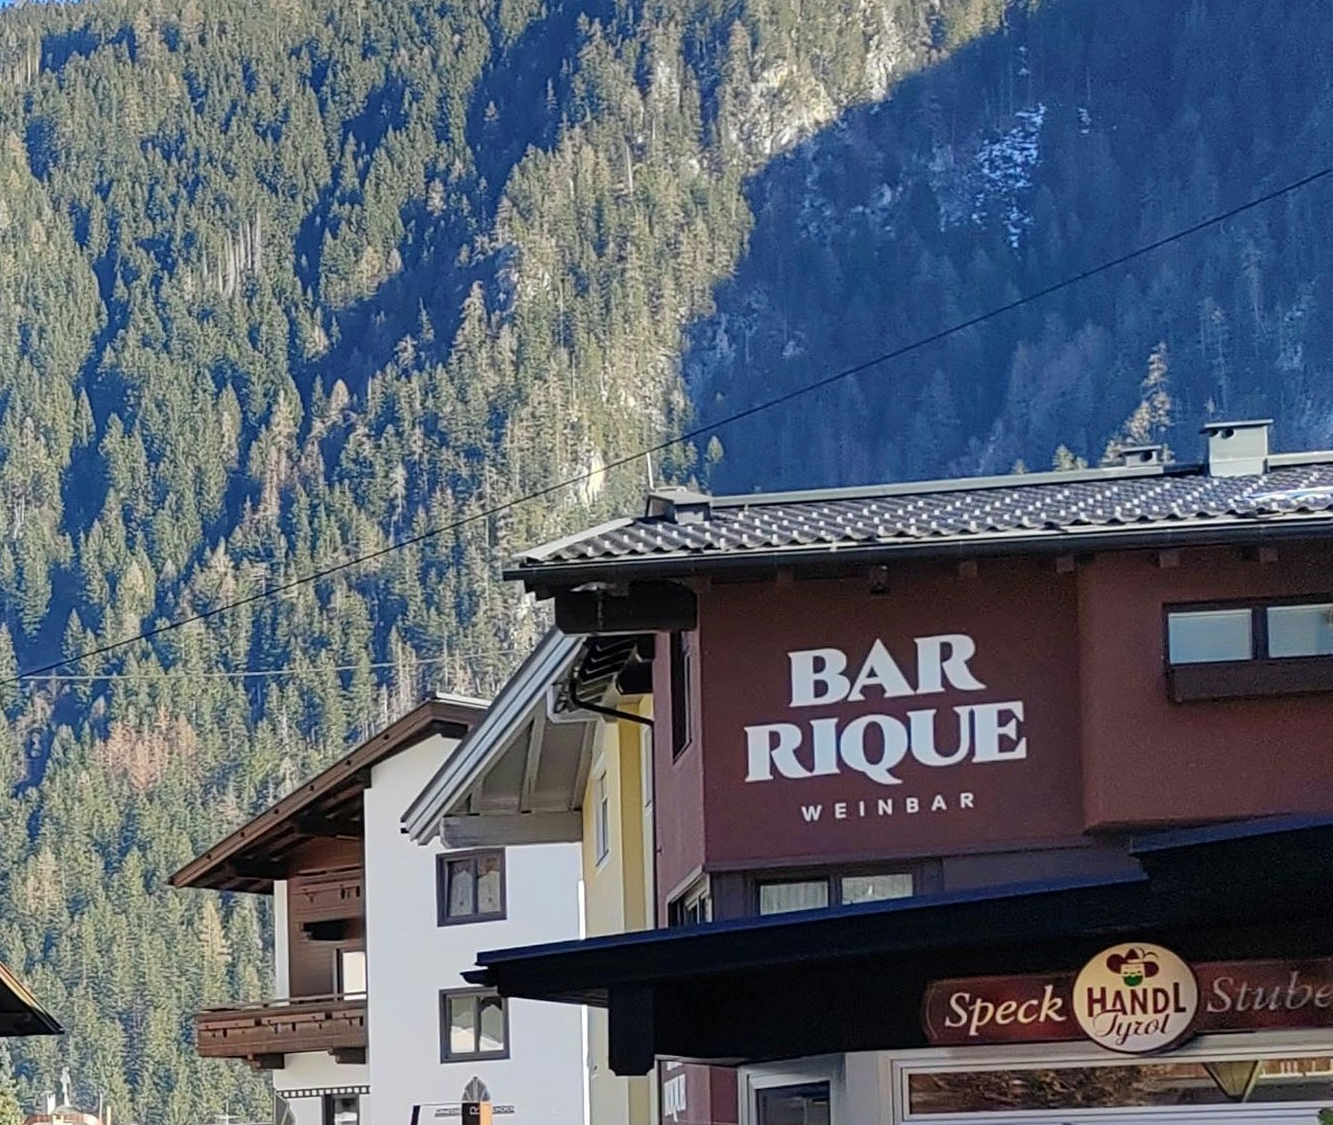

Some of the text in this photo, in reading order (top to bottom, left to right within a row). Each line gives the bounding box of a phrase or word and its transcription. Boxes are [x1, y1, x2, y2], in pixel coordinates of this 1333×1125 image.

[787, 632, 987, 709] BAR
[744, 701, 1027, 785] RIQUE
[801, 792, 975, 822] WEINBAR
[944, 970, 1332, 1037] Speck Stube
[1086, 981, 1187, 1018] HANDL
[1092, 1011, 1170, 1046] Tyrol
